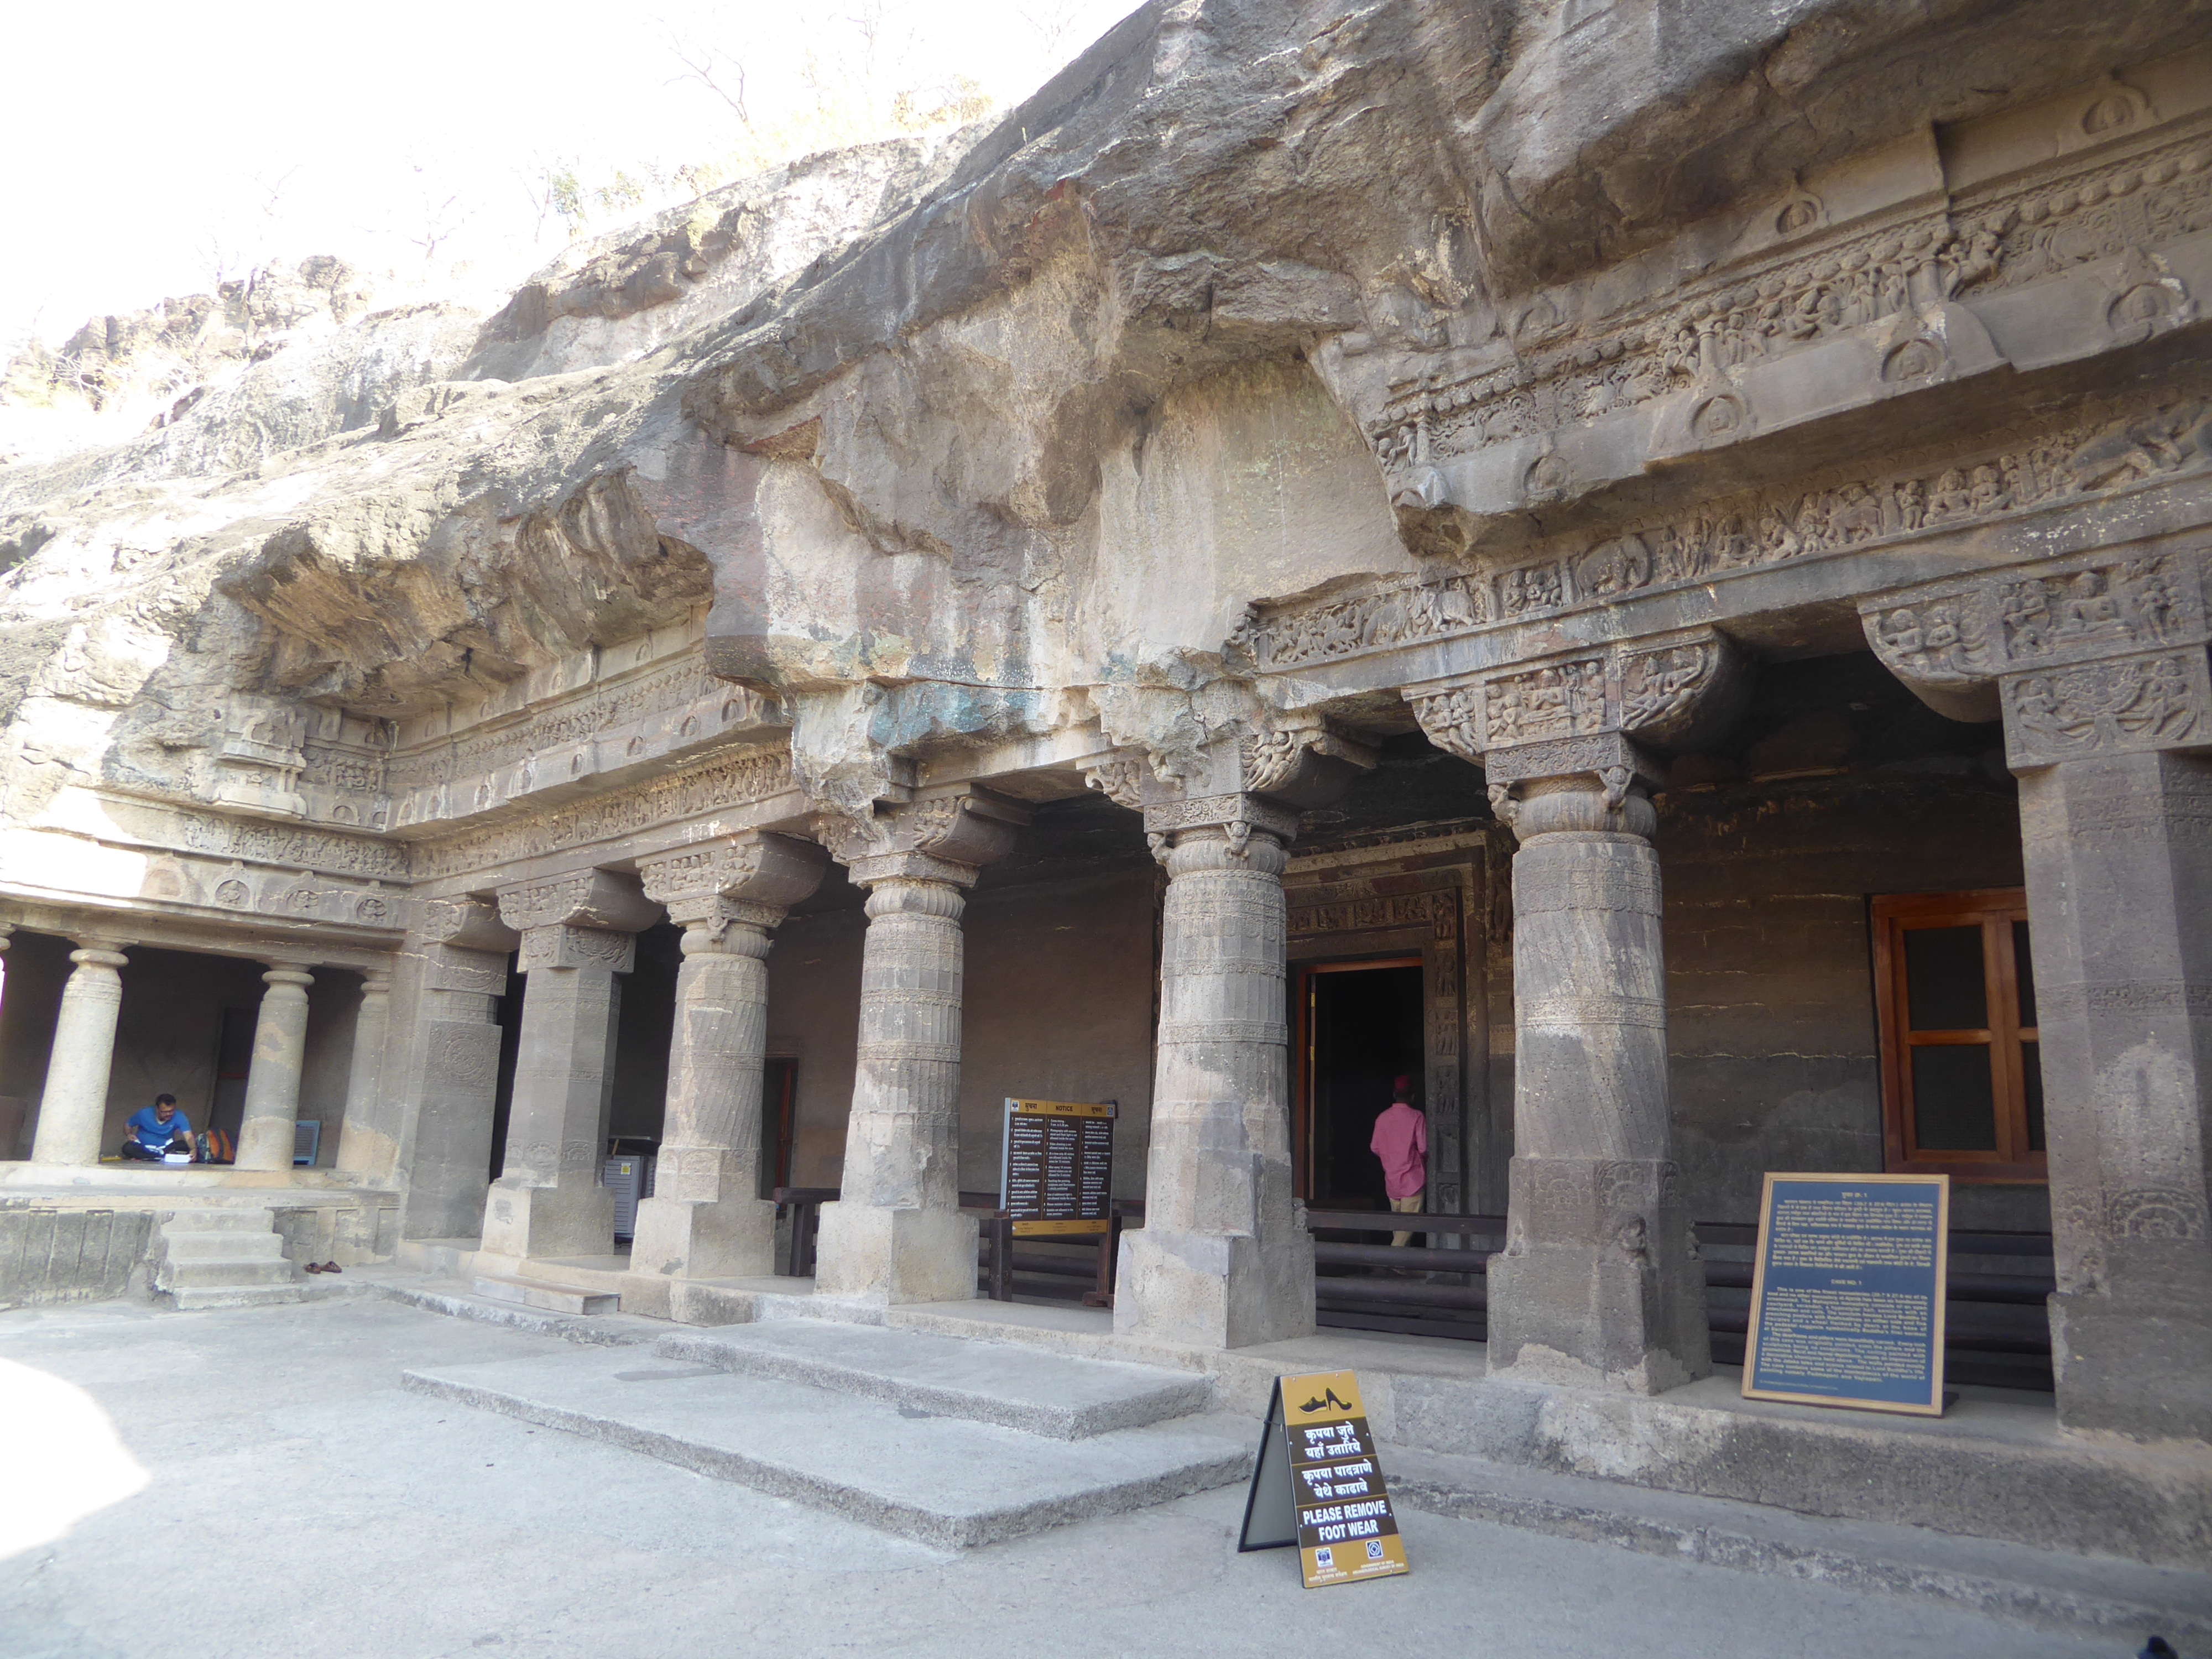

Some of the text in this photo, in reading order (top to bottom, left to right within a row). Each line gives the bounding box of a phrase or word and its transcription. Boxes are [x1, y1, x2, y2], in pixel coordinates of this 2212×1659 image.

[1304, 1427, 1334, 1444] कृपया
[1304, 1438, 1361, 1458] यहाँ उतारिये
[1301, 1458, 1373, 1485] कृपया पादत्राणे
[1313, 1477, 1368, 1498] येथे काढावे
[1303, 1500, 1386, 1525] PLEASE REMOVE
[1318, 1519, 1379, 1541] FOOT WEAR
